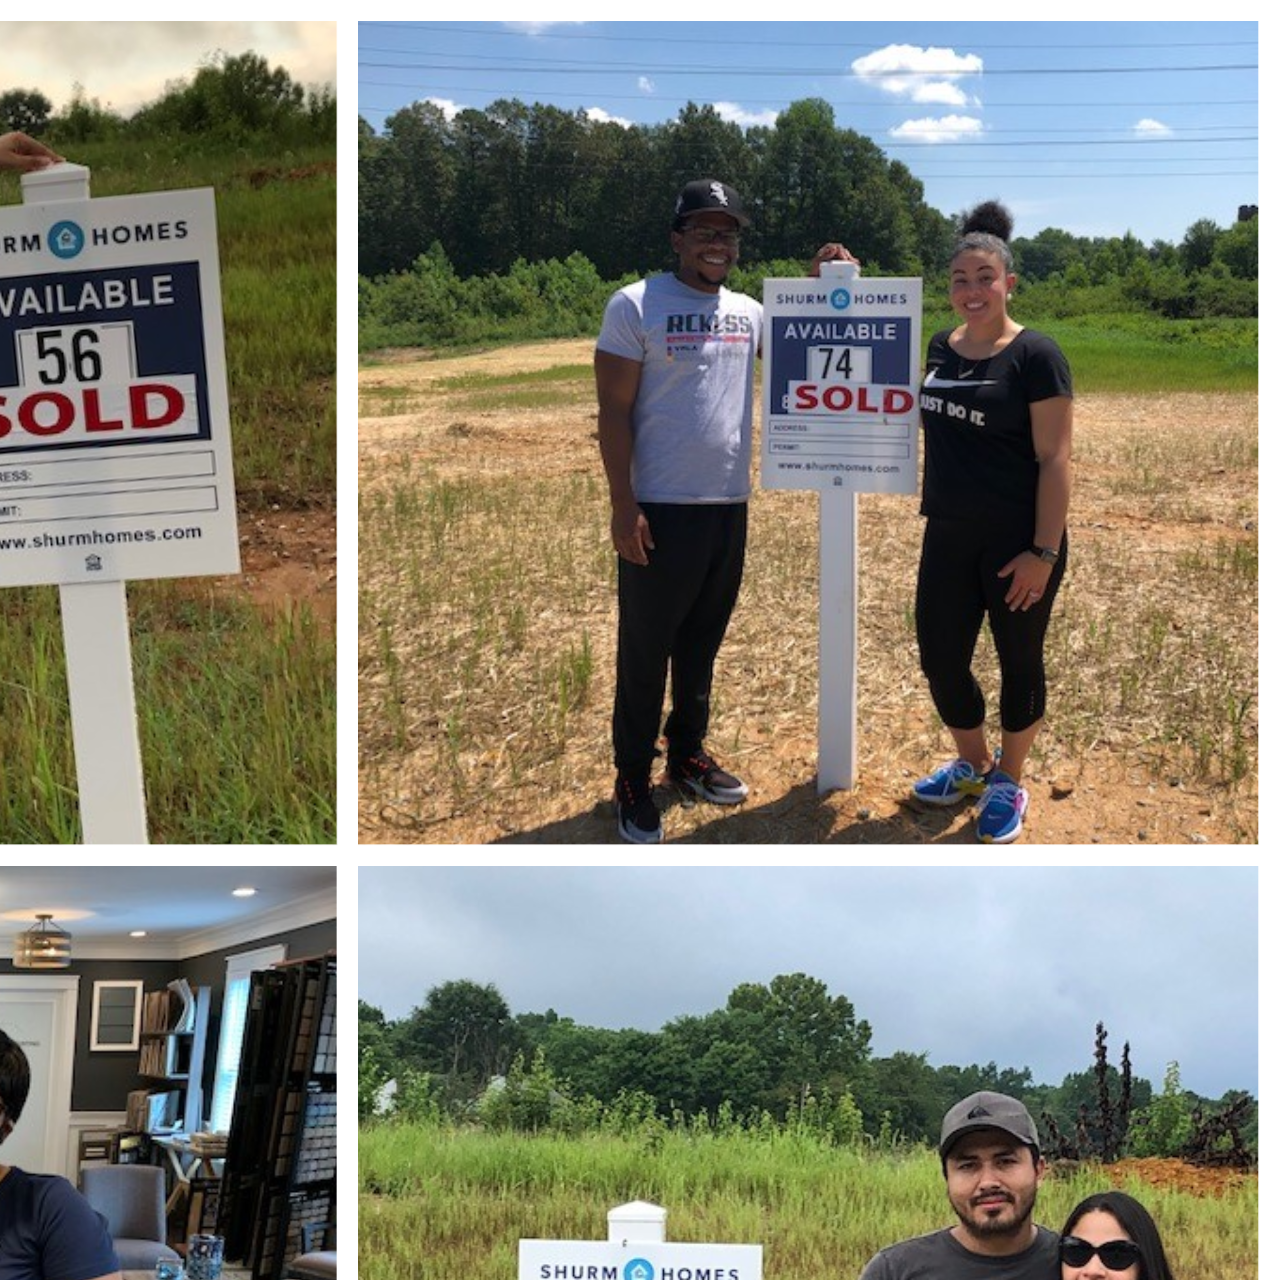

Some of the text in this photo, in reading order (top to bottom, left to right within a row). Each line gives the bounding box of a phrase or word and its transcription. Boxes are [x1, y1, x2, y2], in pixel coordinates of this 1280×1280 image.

[92, 221, 188, 246] HOMES
[776, 293, 908, 305] SHURM HOMES
[785, 323, 897, 340] AVAILABLE
[36, 328, 102, 385] 56
[818, 348, 853, 380] 74
[795, 385, 914, 415] SOLD
[947, 401, 967, 419] DO
[970, 409, 985, 426] IT.
[778, 461, 900, 473] www.shurmhomes.com
